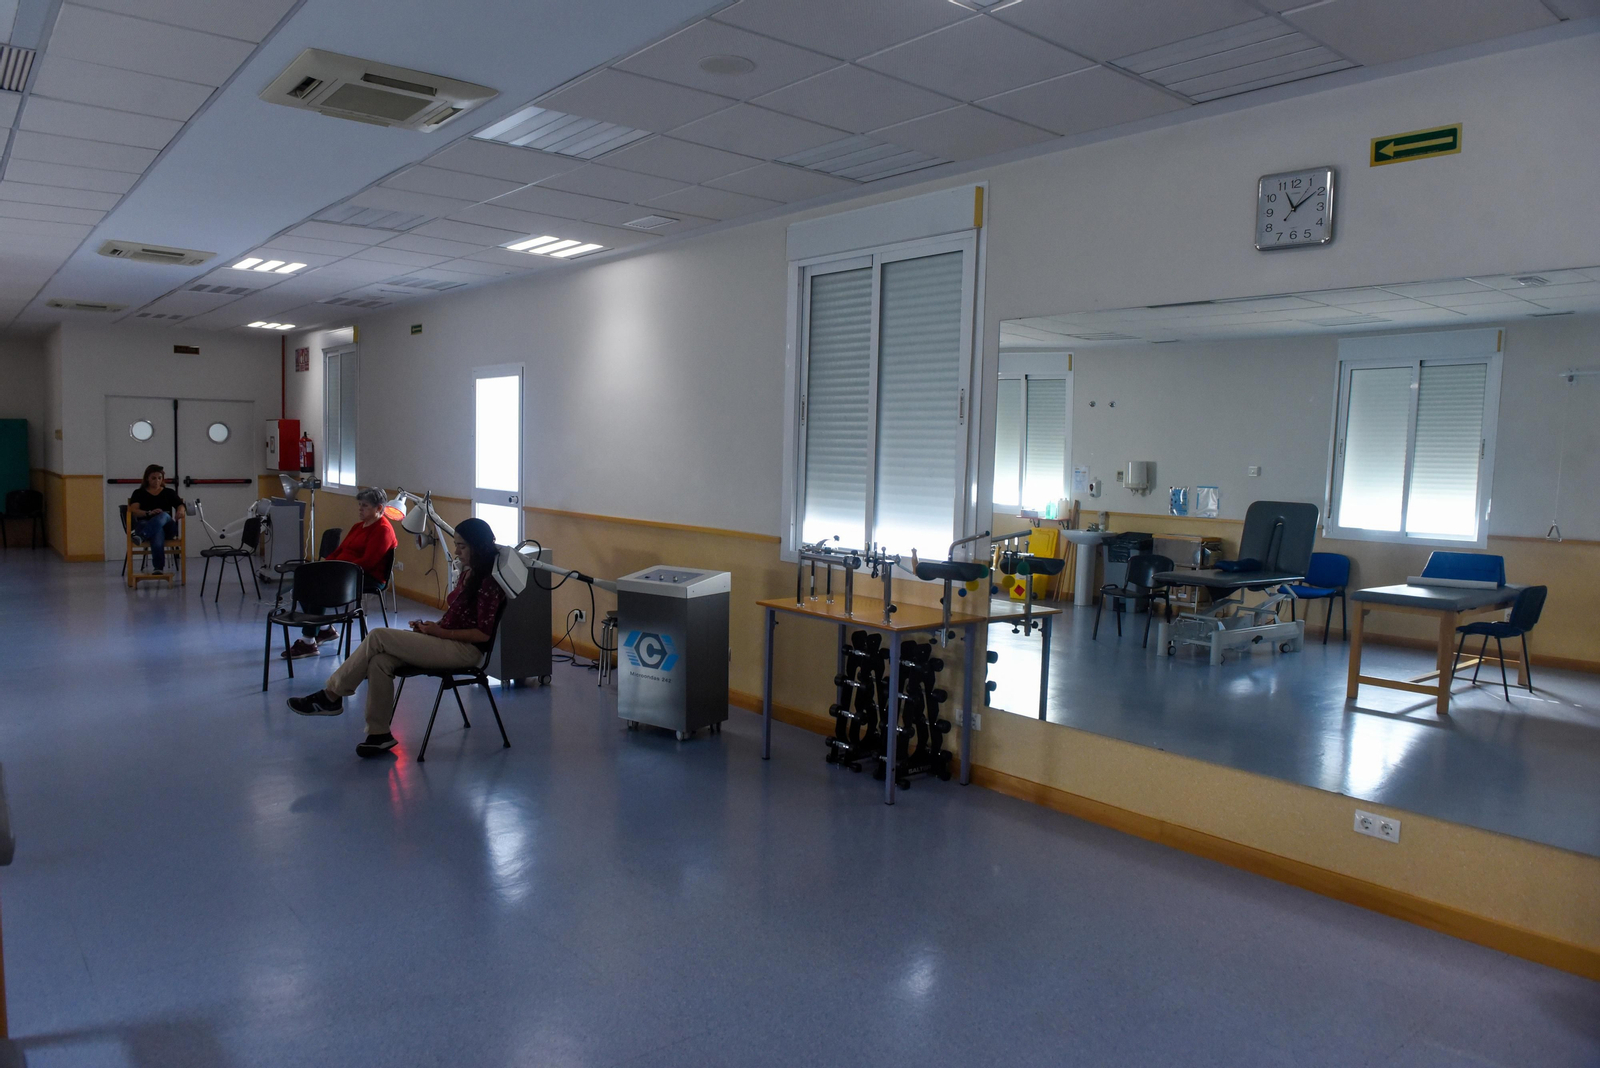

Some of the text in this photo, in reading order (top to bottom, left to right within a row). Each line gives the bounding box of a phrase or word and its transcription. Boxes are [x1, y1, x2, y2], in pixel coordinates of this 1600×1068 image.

[1278, 181, 1287, 191] 11
[1291, 178, 1302, 189] 12
[1317, 186, 1326, 196] 2
[1267, 193, 1277, 203] 10
[1316, 201, 1325, 212] 3
[1266, 208, 1274, 218] 9
[1315, 217, 1324, 227] 4
[1265, 223, 1273, 233] 8
[1276, 232, 1283, 242] 7
[1289, 230, 1298, 240] 6
[1303, 229, 1312, 239] 5
[630, 671, 660, 681] Microondas
